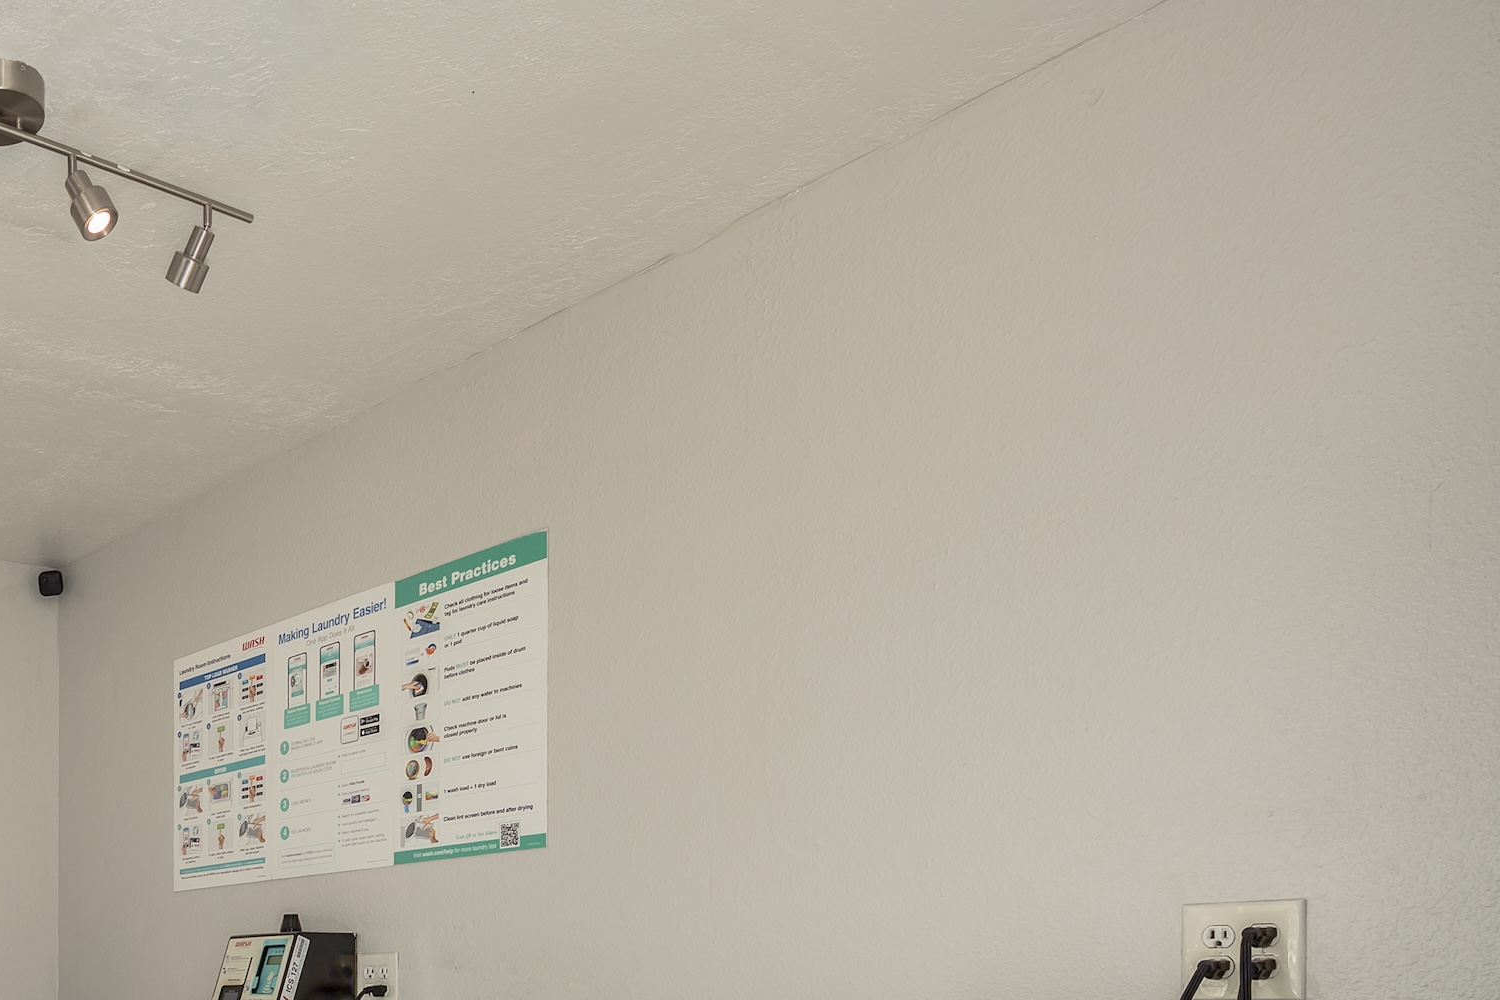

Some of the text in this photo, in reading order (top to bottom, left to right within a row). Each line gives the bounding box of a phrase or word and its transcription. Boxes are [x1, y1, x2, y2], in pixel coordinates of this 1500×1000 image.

[419, 554, 516, 596] Best Practices
[445, 601, 457, 610] Check
[465, 592, 483, 603] clothing
[491, 586, 503, 594] loose
[505, 582, 518, 591] items
[519, 578, 528, 586] and
[459, 602, 475, 614] laundry
[488, 591, 515, 603] instructions
[279, 598, 386, 645] Making Laundry Easier!
[242, 637, 265, 651] WASH
[318, 635, 327, 643] App
[329, 631, 342, 639] Does
[179, 654, 231, 676] Laundry Room Instructions
[444, 724, 457, 732] Check
[458, 720, 476, 729] machine
[444, 727, 477, 739] closed properly
[471, 750, 487, 759] foreign
[481, 809, 495, 817] before
[518, 804, 533, 812] drying
[282, 829, 287, 837] 4
[286, 978, 294, 992] ICS
